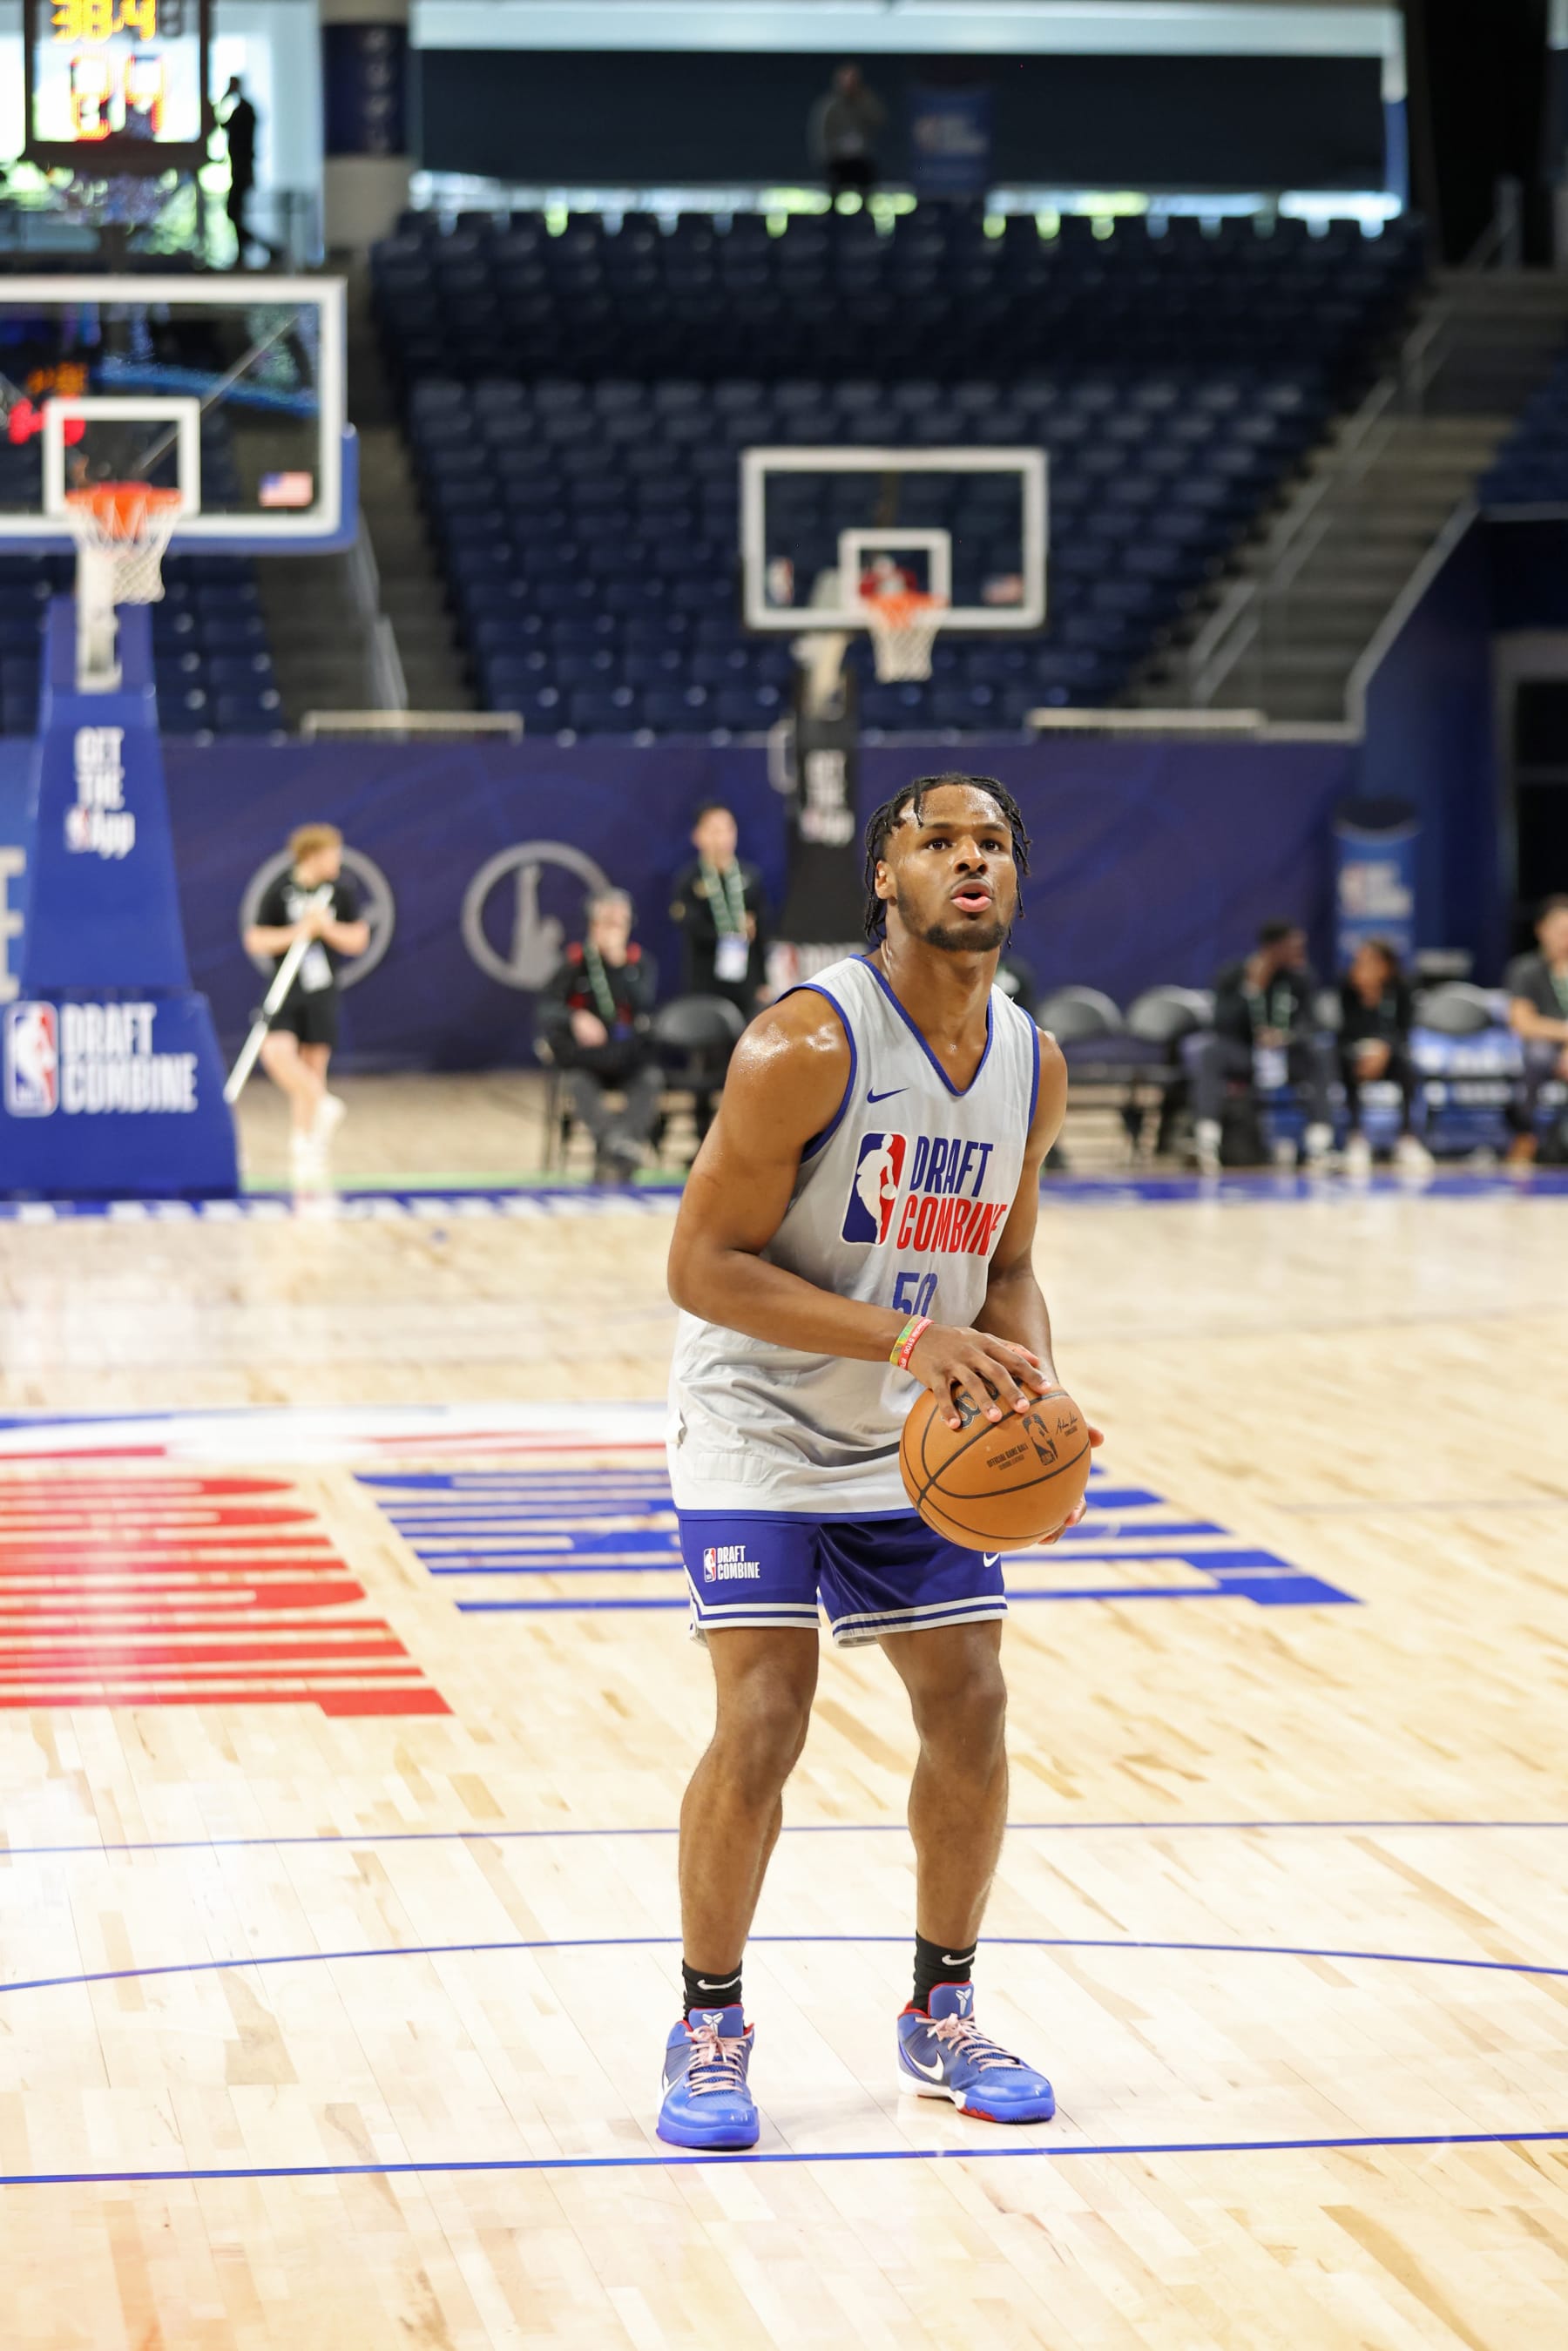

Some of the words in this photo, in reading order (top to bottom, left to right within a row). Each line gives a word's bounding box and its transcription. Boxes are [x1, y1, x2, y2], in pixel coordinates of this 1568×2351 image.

[74, 726, 125, 769] GET
[75, 767, 125, 810] THE
[60, 1001, 158, 1057] DRAFT
[60, 1052, 199, 1115] COMBINE
[909, 1135, 993, 1198] DRAFT
[892, 1272, 937, 1317] 50
[717, 1545, 746, 1564] DRAFT
[717, 1562, 760, 1580] COMBINE
